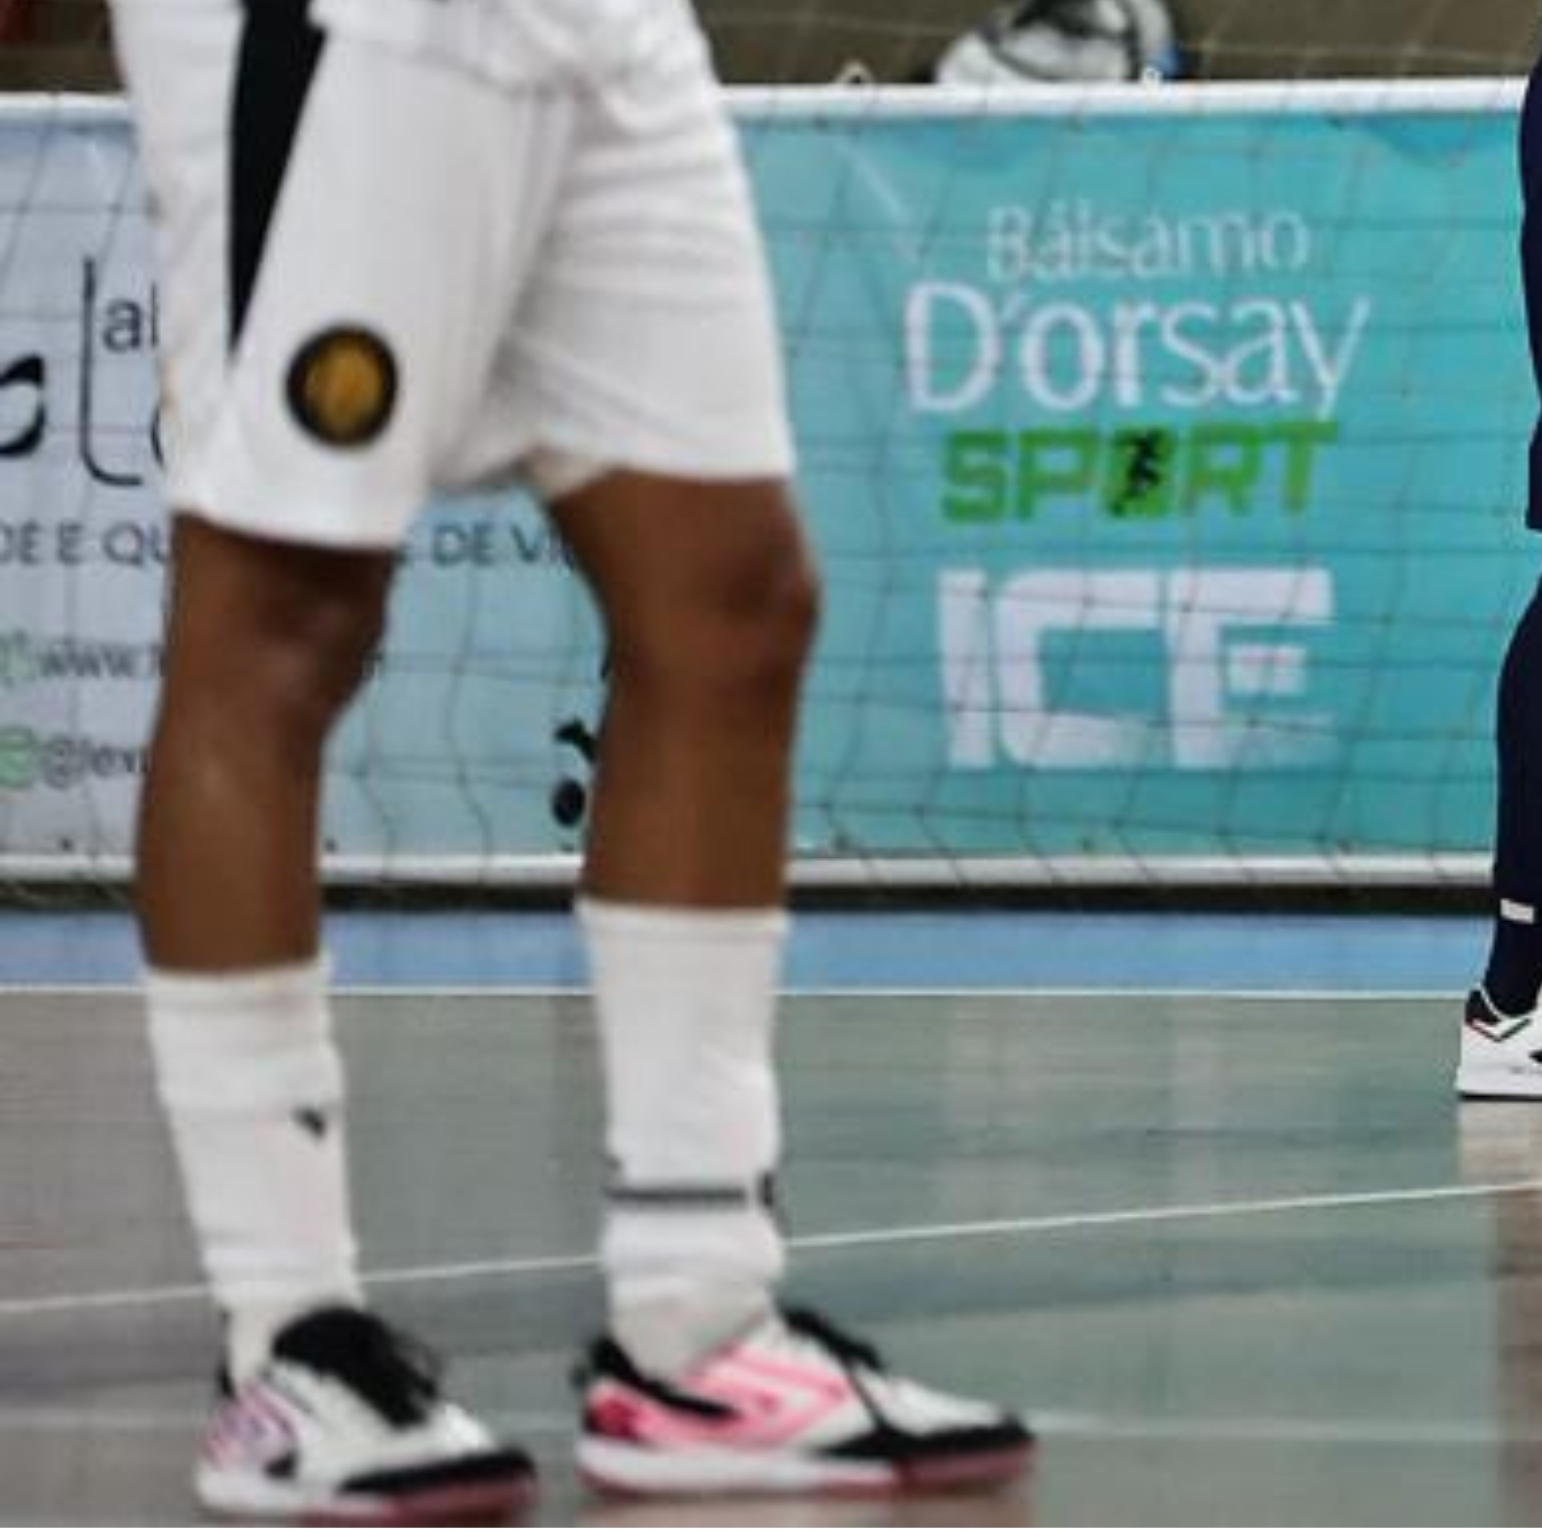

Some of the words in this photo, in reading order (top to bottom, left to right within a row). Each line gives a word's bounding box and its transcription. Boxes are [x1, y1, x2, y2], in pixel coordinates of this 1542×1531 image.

[988, 198, 1312, 280] Bálsamo
[941, 420, 1339, 524] SPORT
[937, 567, 1333, 769] ICE
